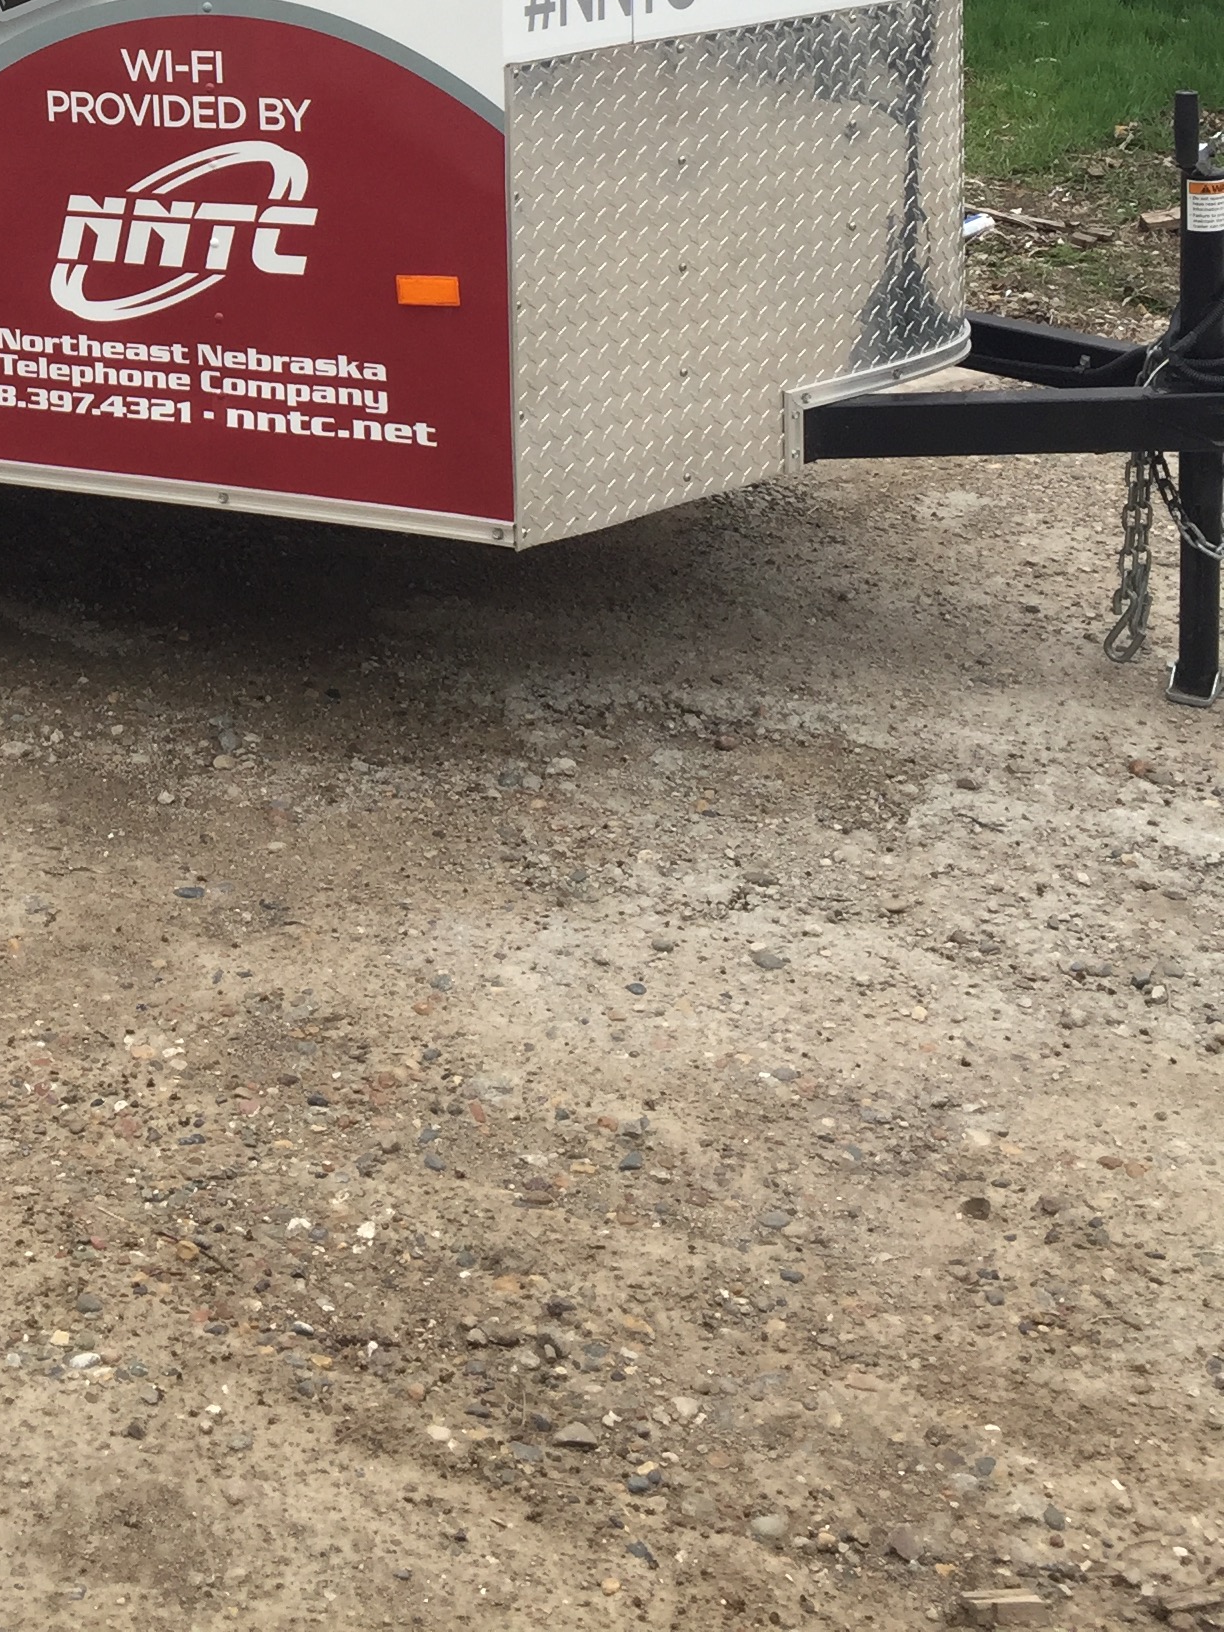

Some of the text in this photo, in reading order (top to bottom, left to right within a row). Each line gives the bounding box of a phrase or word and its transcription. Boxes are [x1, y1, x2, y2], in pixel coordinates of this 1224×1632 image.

[120, 48, 224, 85] WI-FI
[46, 90, 312, 132] PROVIDED BY
[57, 194, 319, 276] NNTC
[197, 343, 388, 382] Nebraska
[200, 371, 389, 414] Company
[226, 406, 438, 448] nntc.net
